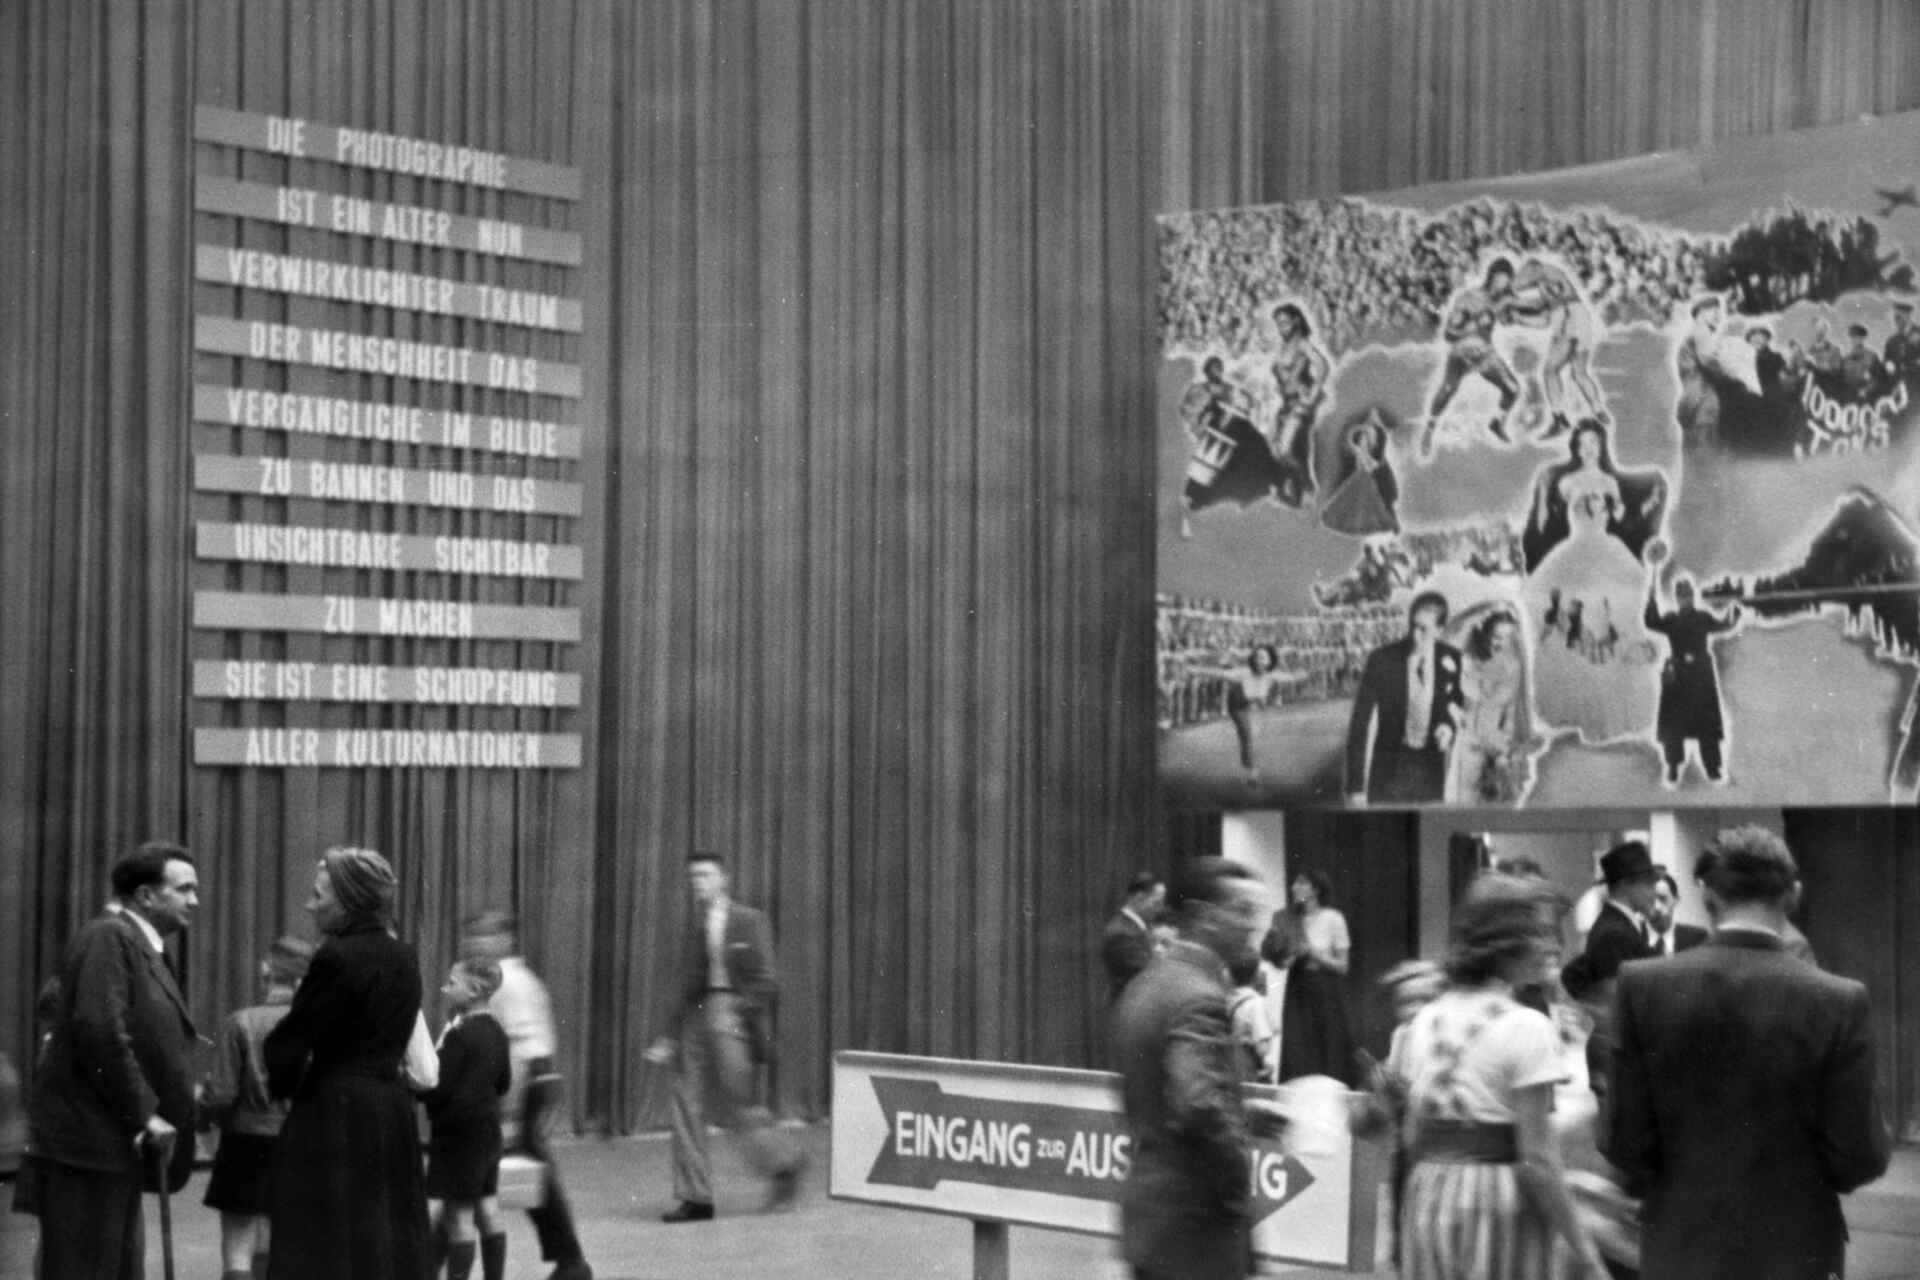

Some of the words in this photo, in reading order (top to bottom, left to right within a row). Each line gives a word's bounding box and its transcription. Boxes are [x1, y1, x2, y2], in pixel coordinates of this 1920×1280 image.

[267, 115, 306, 157] DIE
[337, 127, 508, 189] PHOTOGRAPHIE
[278, 187, 318, 227] IST
[333, 194, 371, 234] EIN
[382, 203, 452, 246] ALTER
[228, 250, 454, 314] VERWIRKLICHTER
[477, 285, 558, 329] TRAUM
[250, 322, 301, 362] DER
[311, 328, 472, 384] MENSCHHEIT
[489, 352, 537, 392] DAS
[442, 411, 471, 448] IM
[490, 417, 558, 457] BILDE
[260, 457, 292, 495] ZU
[311, 460, 404, 503] BANNEN
[429, 470, 474, 507] UND
[493, 476, 536, 512] DAS
[234, 523, 401, 568] UNSICHTBARE
[435, 536, 551, 577] SICHTBAR
[324, 596, 355, 633] ZU
[379, 598, 473, 637] MACHEN
[225, 661, 267, 698] SIE
[276, 662, 316, 699] IST
[332, 665, 389, 701] EINE
[245, 728, 320, 765] ALLER
[335, 730, 542, 767] KULTURNATIONEN
[895, 1111, 1031, 1169] EINGANG
